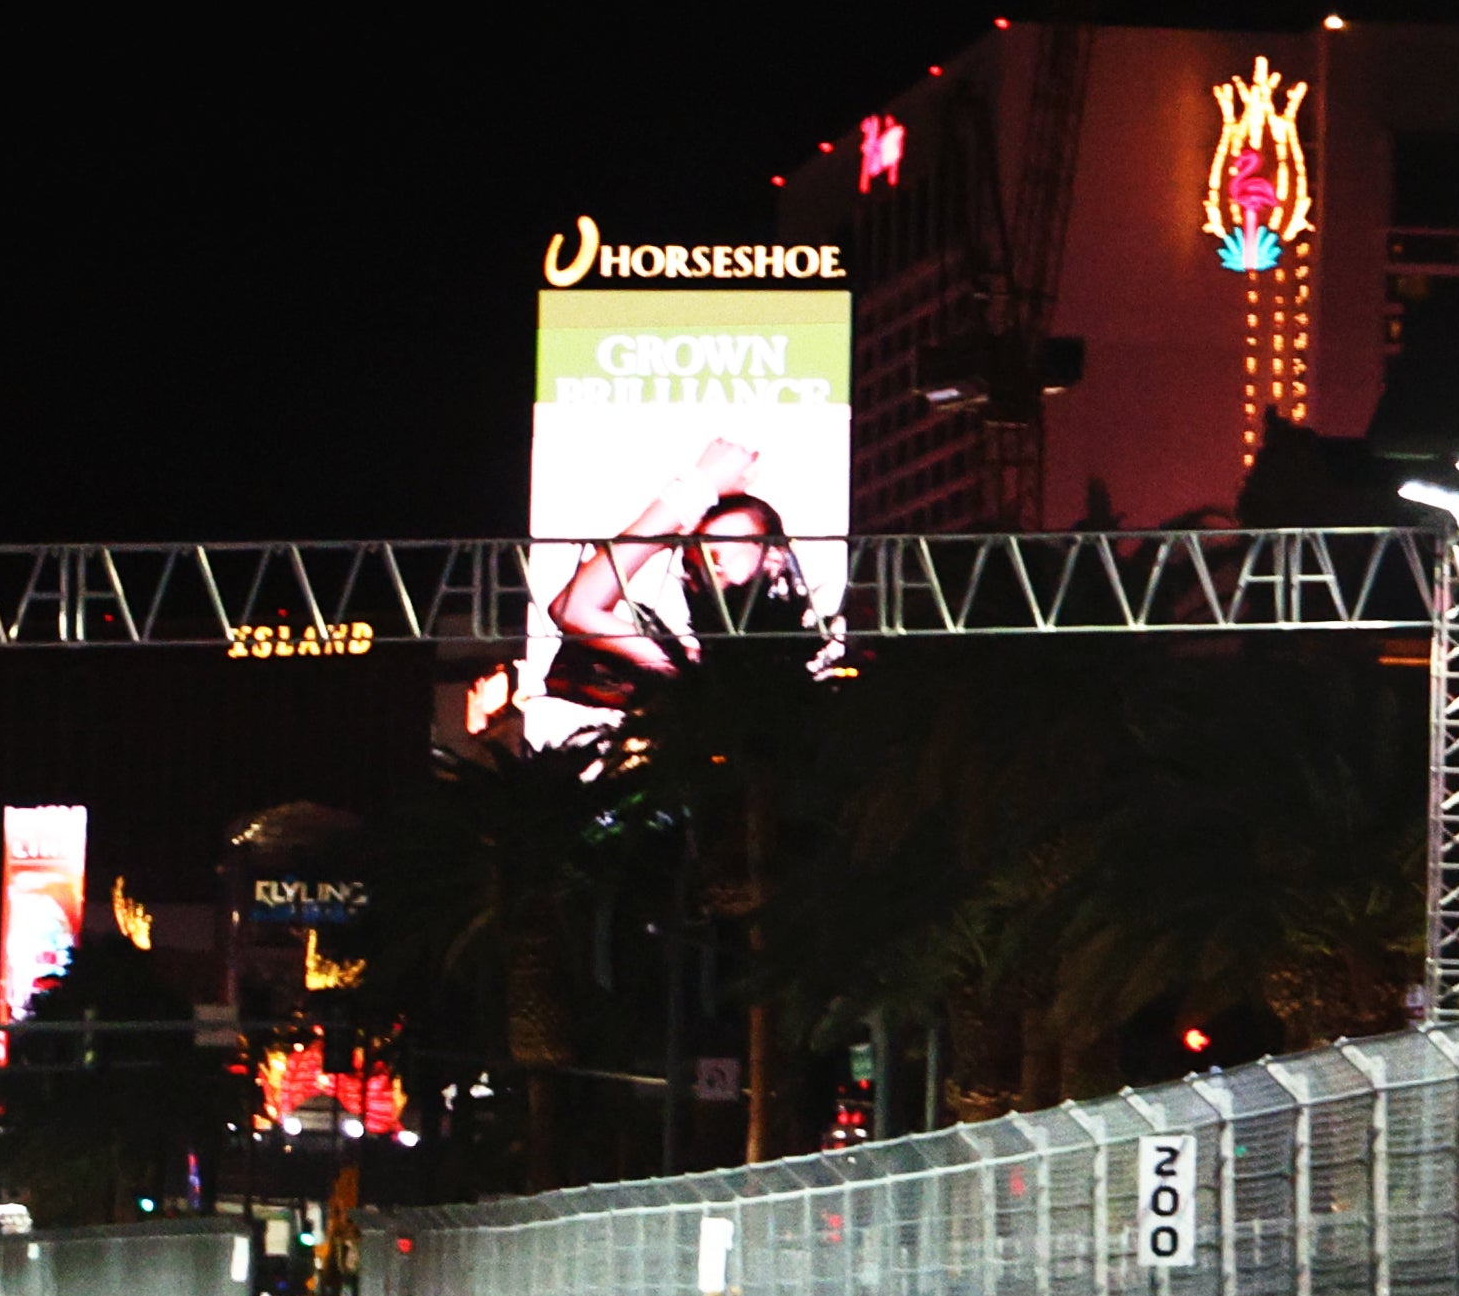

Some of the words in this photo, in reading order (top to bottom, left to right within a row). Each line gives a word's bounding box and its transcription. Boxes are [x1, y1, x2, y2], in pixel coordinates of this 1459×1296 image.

[599, 244, 846, 278] HORSESHOE
[596, 334, 789, 376] GROWN
[1151, 1146, 1182, 1258] 200
